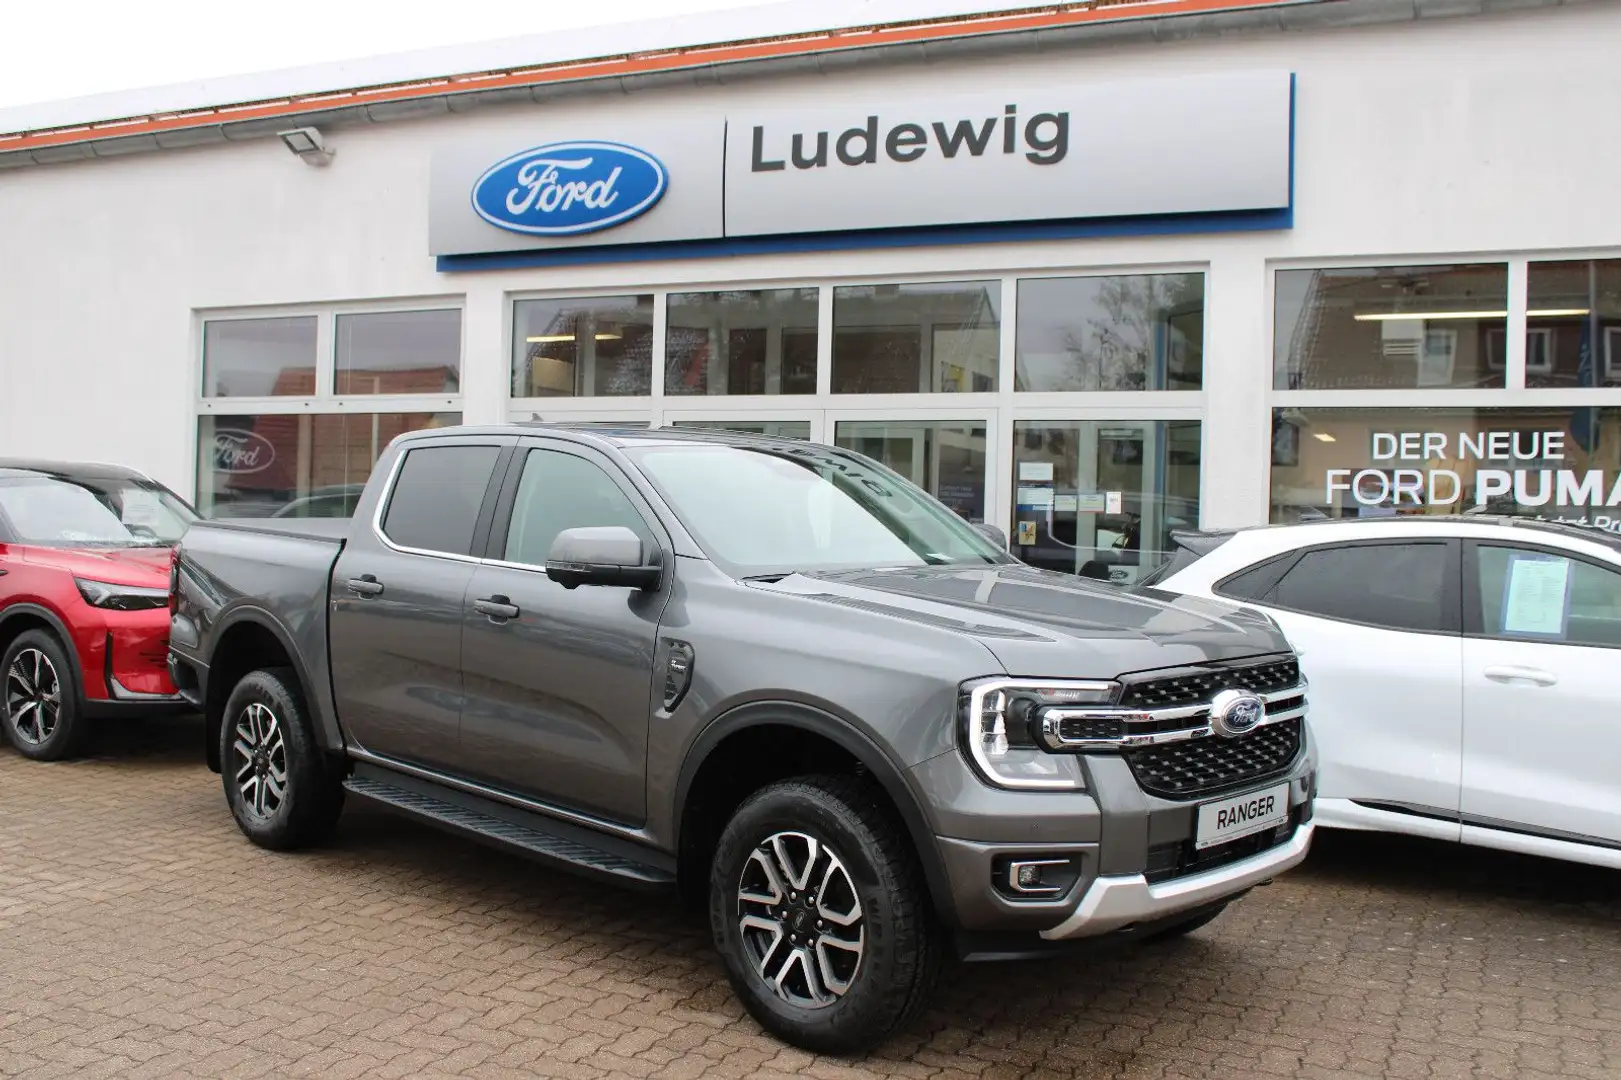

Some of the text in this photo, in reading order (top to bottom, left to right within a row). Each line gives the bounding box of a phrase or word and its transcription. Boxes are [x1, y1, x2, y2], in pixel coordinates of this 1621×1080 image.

[751, 105, 1069, 173] Ludewig
[506, 157, 623, 215] Ford
[1372, 431, 1566, 460] DER NEUE
[1325, 469, 1462, 506] FORD
[1216, 796, 1274, 829] RANGER
